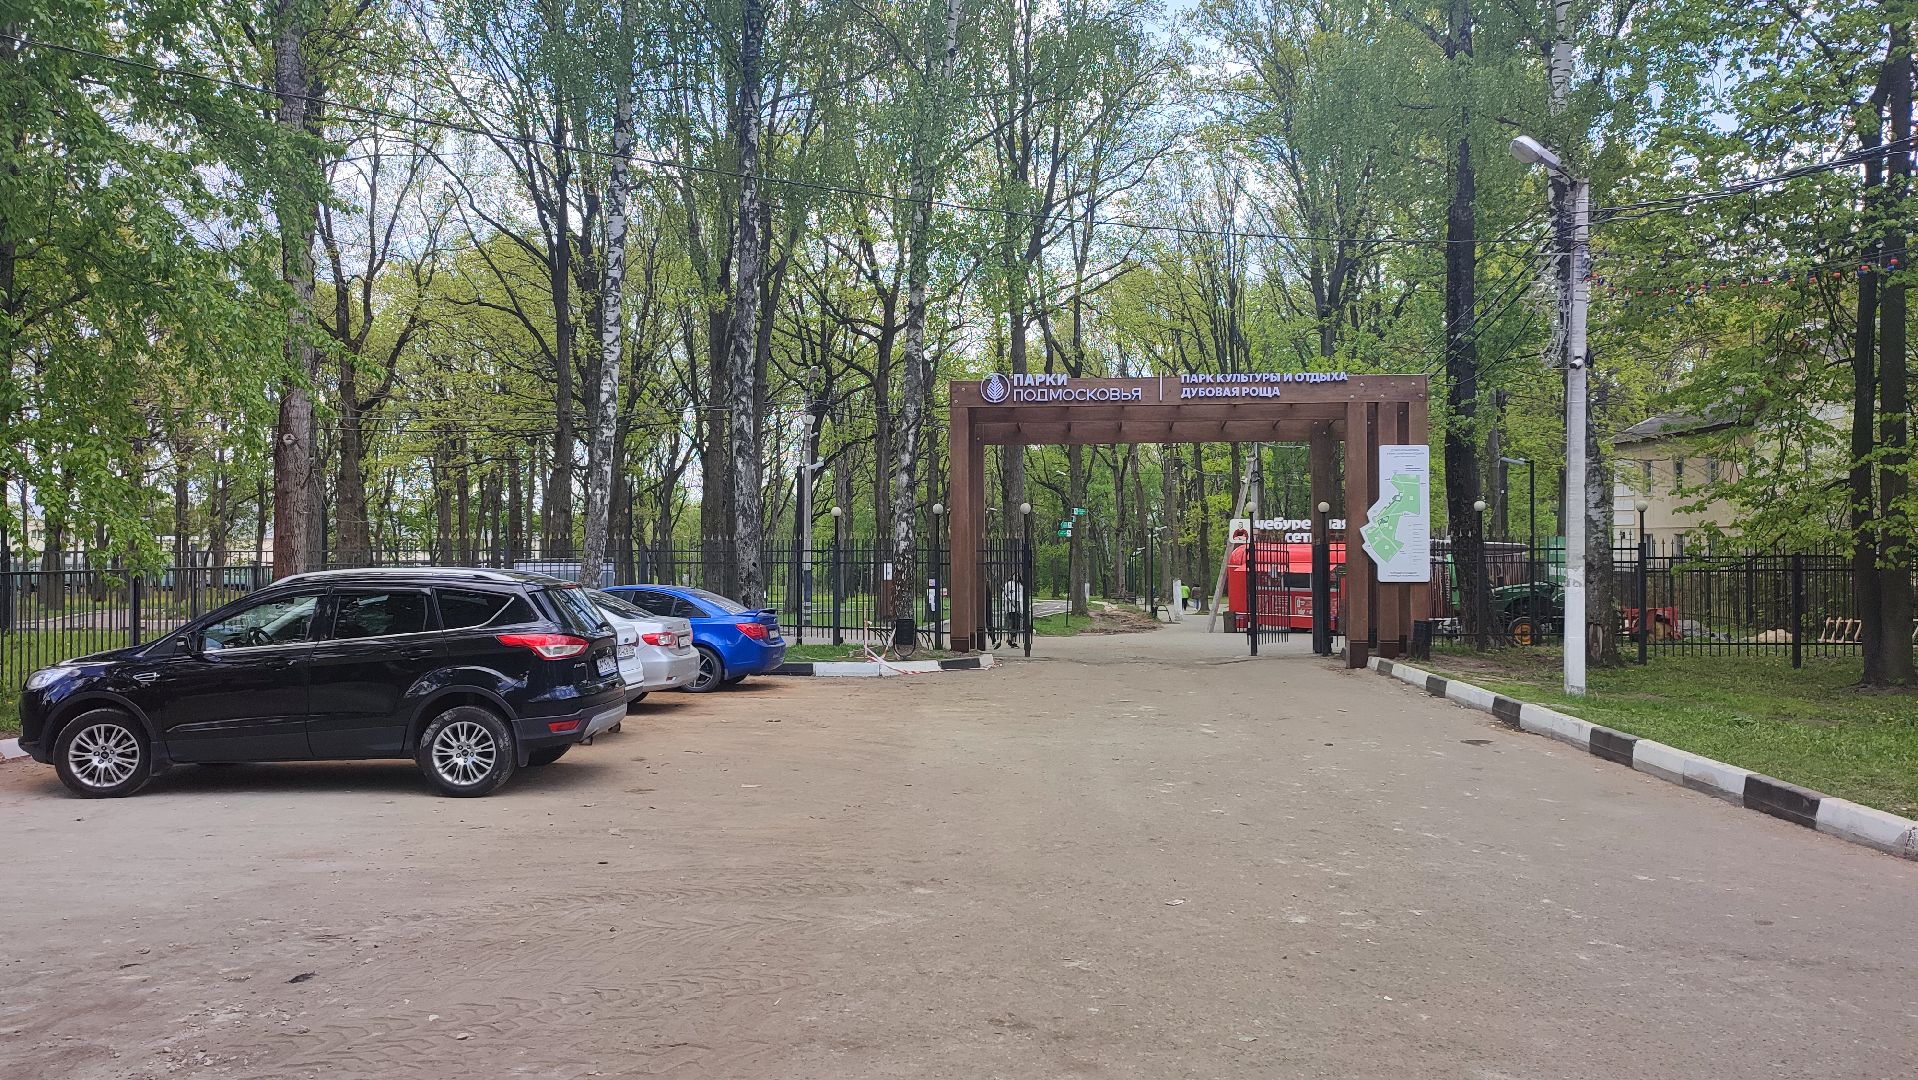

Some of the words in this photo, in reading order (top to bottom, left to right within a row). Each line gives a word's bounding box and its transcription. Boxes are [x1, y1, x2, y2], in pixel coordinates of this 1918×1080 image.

[1013, 373, 1068, 387] ПАРКИ
[1180, 373, 1215, 384] ПАРК
[1216, 373, 1281, 383] КУЛЬТУРЫ
[1283, 372, 1293, 382] И
[1294, 371, 1348, 382] ОТДЫХА
[1013, 387, 1142, 402] ПОДМОСКОВЬЯ
[1180, 386, 1240, 399] ДУБОВАЯ
[1241, 386, 1281, 398] РОЩА
